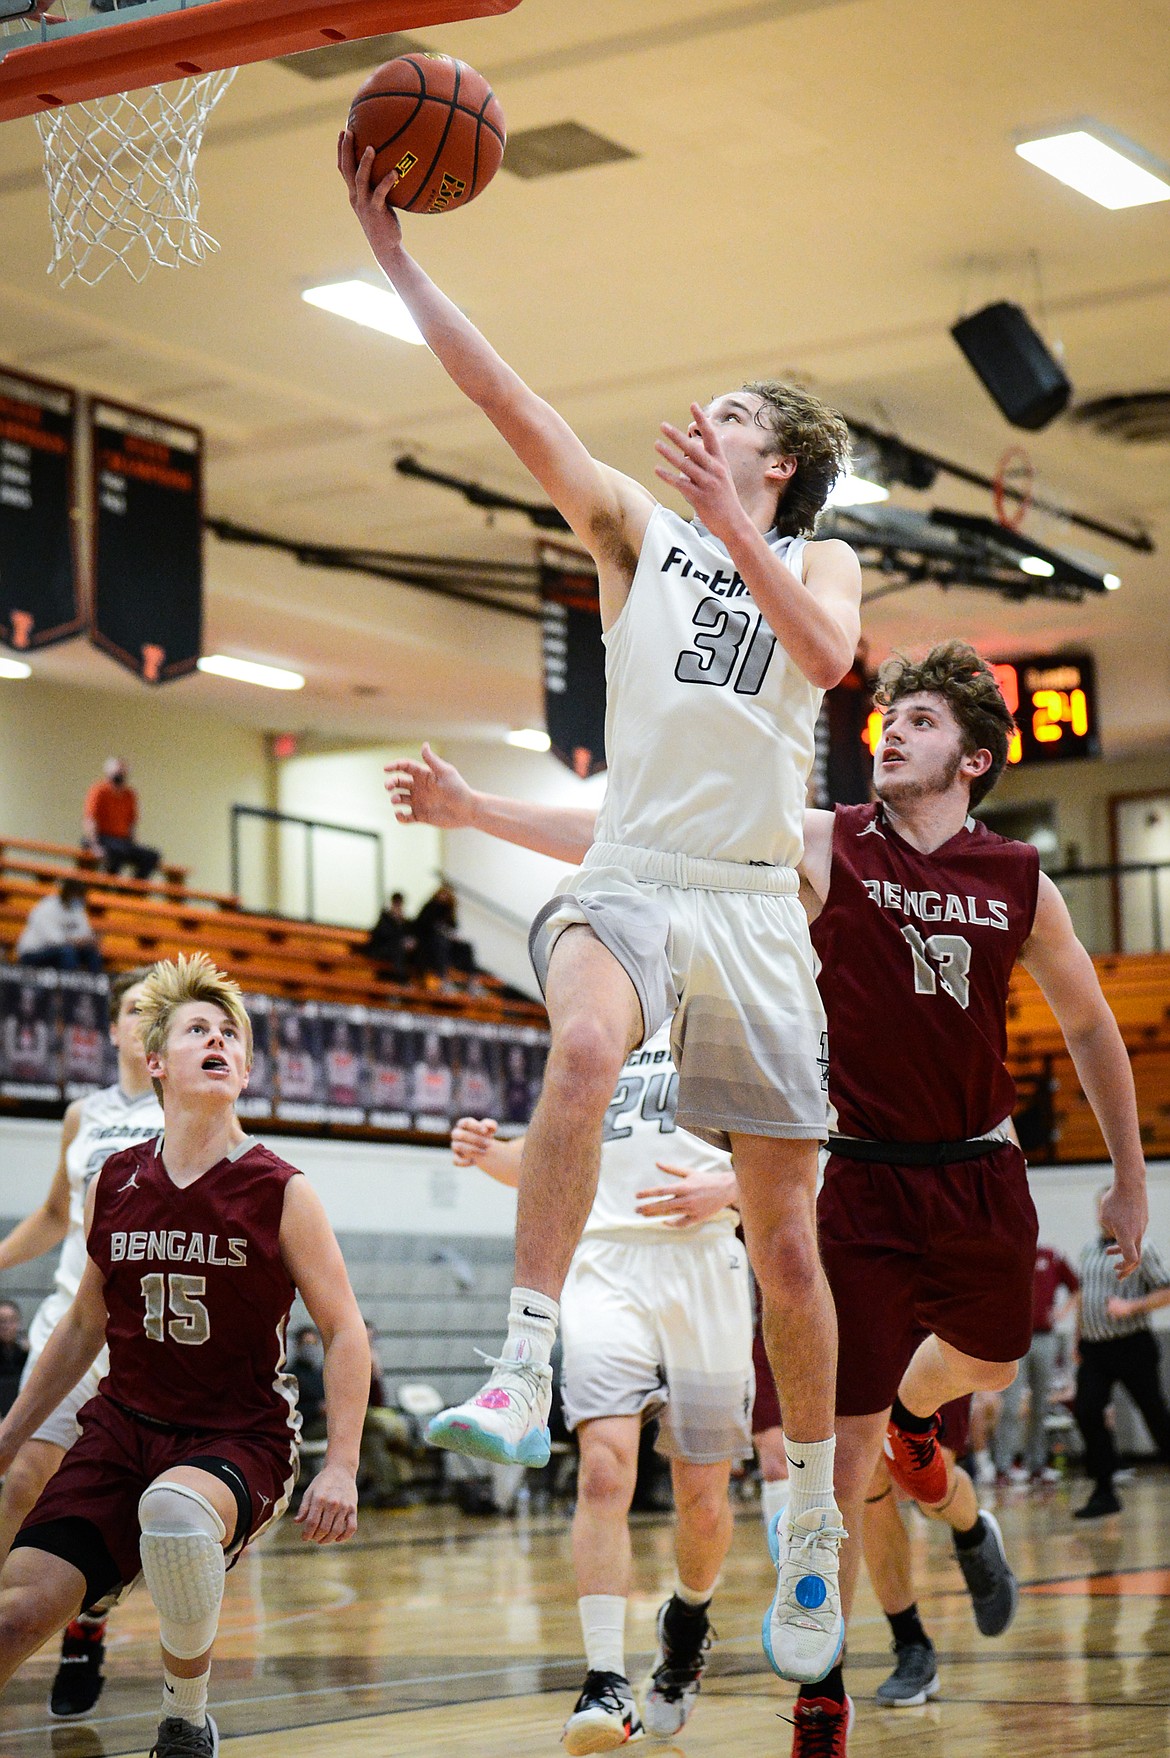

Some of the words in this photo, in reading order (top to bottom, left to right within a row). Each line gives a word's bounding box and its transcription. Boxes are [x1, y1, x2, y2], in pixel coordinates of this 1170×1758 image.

[673, 596, 777, 695] 31
[861, 880, 1009, 931] BENGALS
[900, 924, 972, 1010] 13
[603, 1072, 680, 1142] 24
[111, 1231, 247, 1266] BENGALS
[140, 1272, 211, 1346] 15
